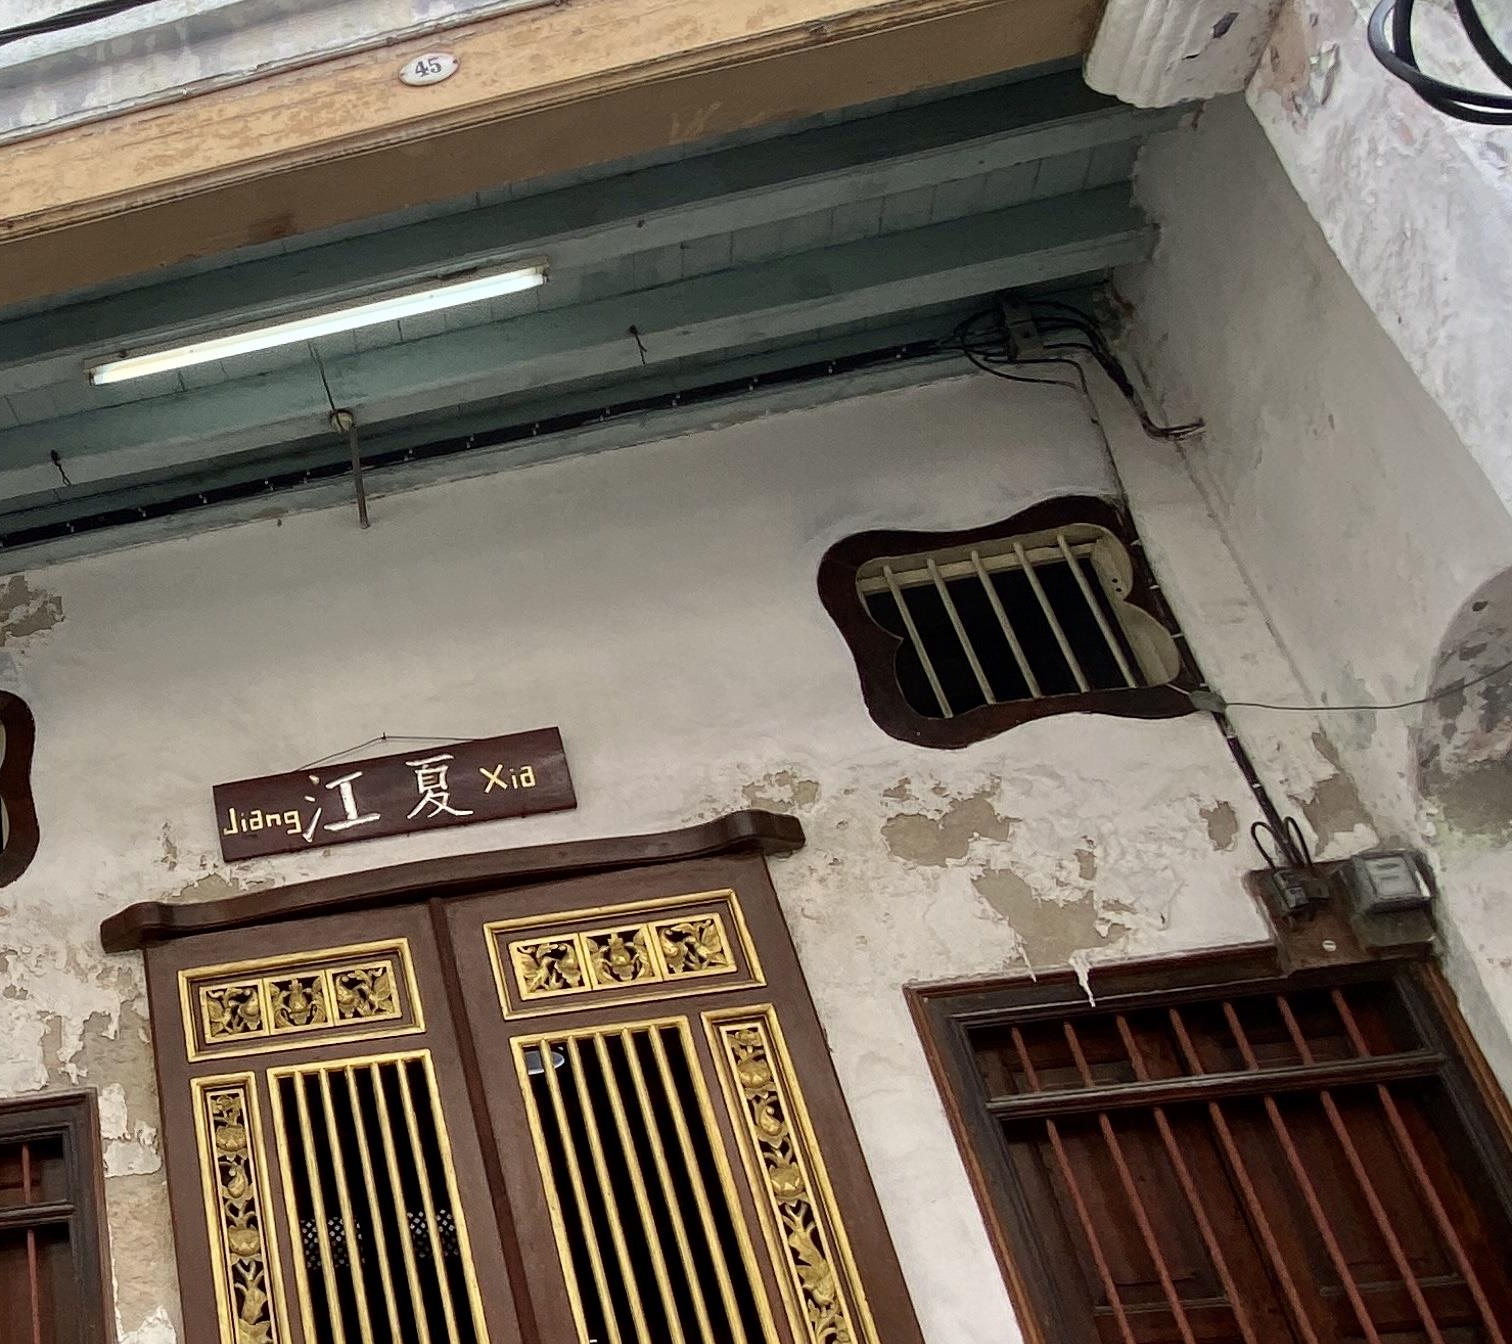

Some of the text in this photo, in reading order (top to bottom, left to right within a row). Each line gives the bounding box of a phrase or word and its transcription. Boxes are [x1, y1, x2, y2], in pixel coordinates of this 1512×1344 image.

[414, 57, 442, 77] 45
[223, 753, 537, 844] Jiang 江夏 Xia
